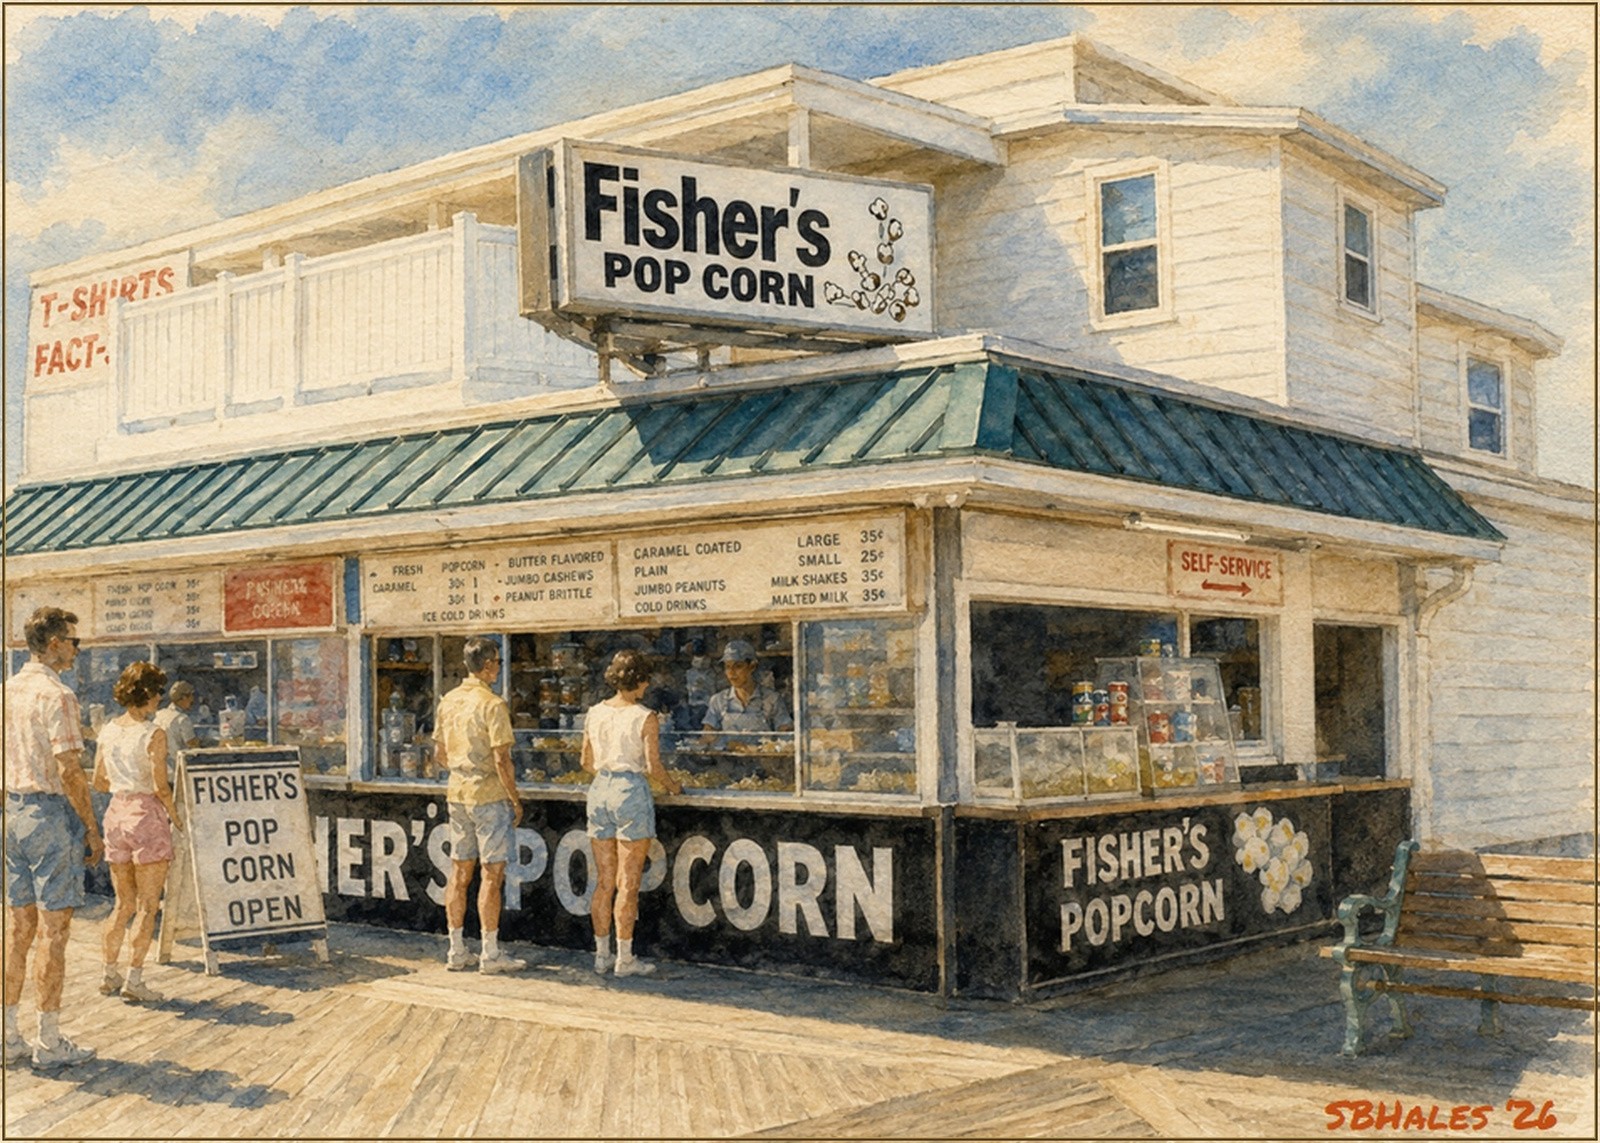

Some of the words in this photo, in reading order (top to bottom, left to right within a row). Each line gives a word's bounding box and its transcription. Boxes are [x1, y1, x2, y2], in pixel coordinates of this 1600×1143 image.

[583, 161, 832, 268] Fisher's
[604, 252, 691, 295] POP
[702, 263, 815, 308] CORN
[34, 333, 109, 378] FACT-
[797, 533, 840, 548] LARGE
[860, 529, 884, 543] 35¢
[633, 545, 690, 560] CARAMEL
[695, 540, 742, 555] COATED
[798, 554, 842, 567] SMALL
[860, 550, 885, 563] 25¢
[393, 564, 423, 576] FRESH
[441, 560, 486, 573] POPCORN
[508, 556, 547, 569] BUTTER
[551, 551, 604, 566] FLAVORED
[1181, 551, 1272, 580] SELF-SERVICE
[505, 575, 540, 586] JUMBO
[544, 570, 594, 584] CASHEWS
[634, 565, 668, 578] PLAIN
[771, 575, 799, 588] MILK
[802, 571, 848, 586] SHAKES
[861, 569, 884, 583] 35¢
[373, 582, 417, 593] CARAMEL
[505, 591, 545, 603] PEANUT
[549, 587, 593, 600] BRITTLE
[634, 585, 672, 597] JUMBO
[675, 579, 726, 593] PEANUTS
[772, 593, 816, 606] MALTED
[820, 590, 849, 604] MILK
[862, 588, 886, 602] 35¢
[635, 601, 663, 613] COLD
[666, 598, 707, 612] DRINKS
[423, 612, 437, 622] ICE
[440, 609, 466, 622] COLD
[193, 771, 299, 804] FISHER'S
[224, 818, 279, 847] POP
[1061, 817, 1210, 888] FISHER'S
[221, 852, 296, 884] CORN
[228, 894, 303, 926] OPEN
[1060, 878, 1225, 952] POPCORN
